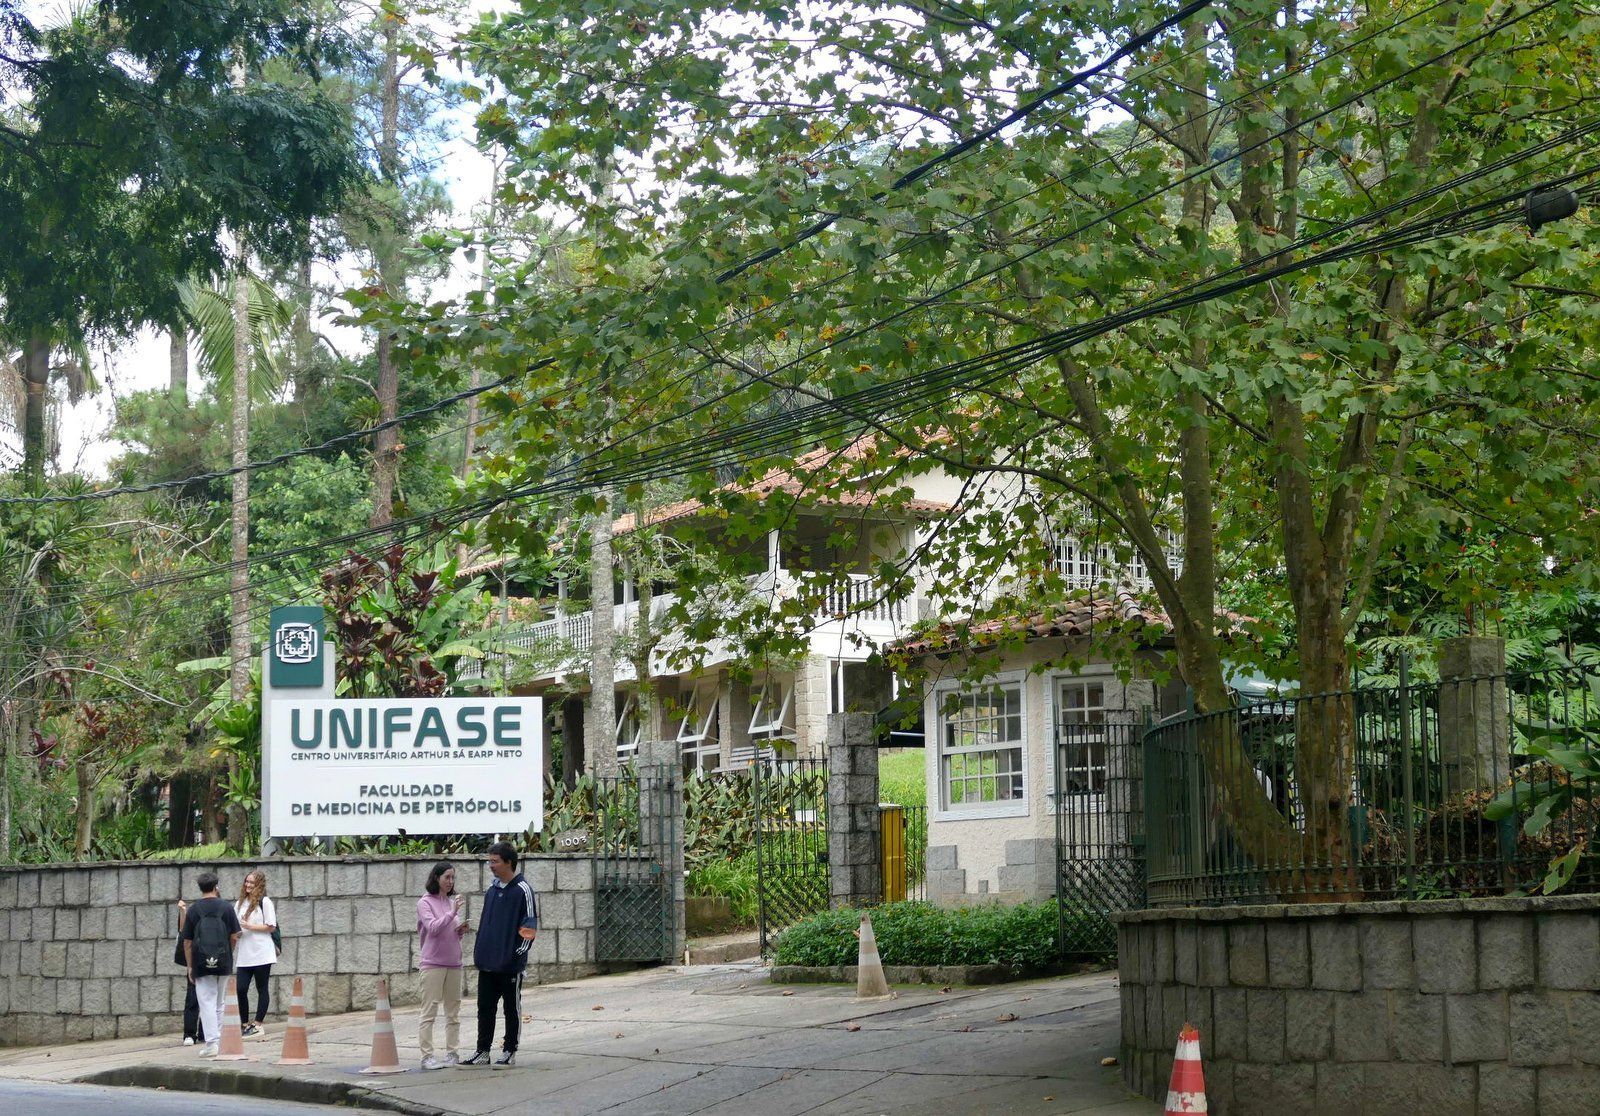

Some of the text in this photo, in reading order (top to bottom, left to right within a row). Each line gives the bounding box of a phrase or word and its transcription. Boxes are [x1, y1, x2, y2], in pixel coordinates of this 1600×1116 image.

[291, 706, 522, 749] UNIFASE
[291, 748, 523, 761] CENTRO UNIVERSITÁRIO ARTHUR SÁ EARP NETO
[359, 784, 454, 797] FACULDADE
[291, 798, 522, 816] DE MEDICINA DE PETRÓPOLIS
